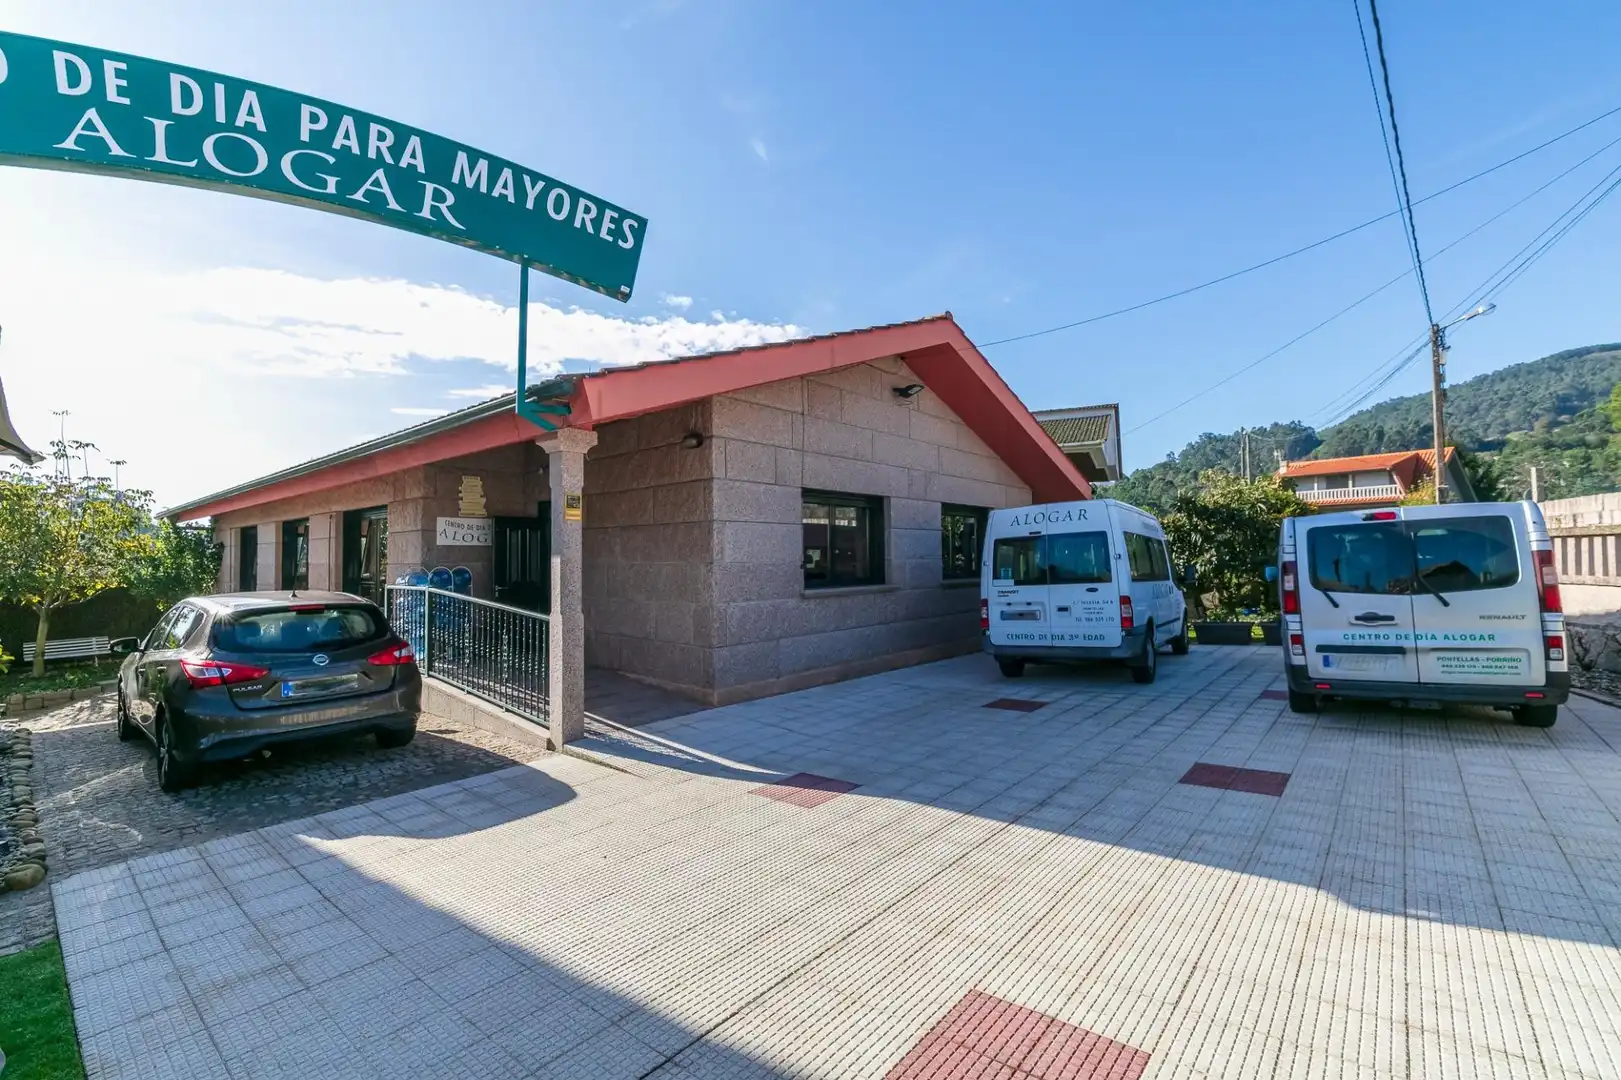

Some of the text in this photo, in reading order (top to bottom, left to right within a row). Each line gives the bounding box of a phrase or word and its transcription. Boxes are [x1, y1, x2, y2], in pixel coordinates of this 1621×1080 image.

[52, 50, 131, 105] DE
[170, 72, 267, 132] DIA
[300, 103, 426, 174] PARA
[452, 151, 640, 250] MAYORES
[53, 107, 467, 230] ALOGAR
[445, 519, 465, 530] CENTRO
[1009, 508, 1088, 528] ALOGAR
[1006, 633, 1036, 641] CENTRO
[1038, 633, 1049, 641] DE
[1051, 633, 1066, 641] DIA
[1083, 633, 1106, 641] EDAD
[1343, 633, 1391, 641] CENTRO
[1395, 633, 1411, 641] DE
[1443, 633, 1497, 642] ALOGAR
